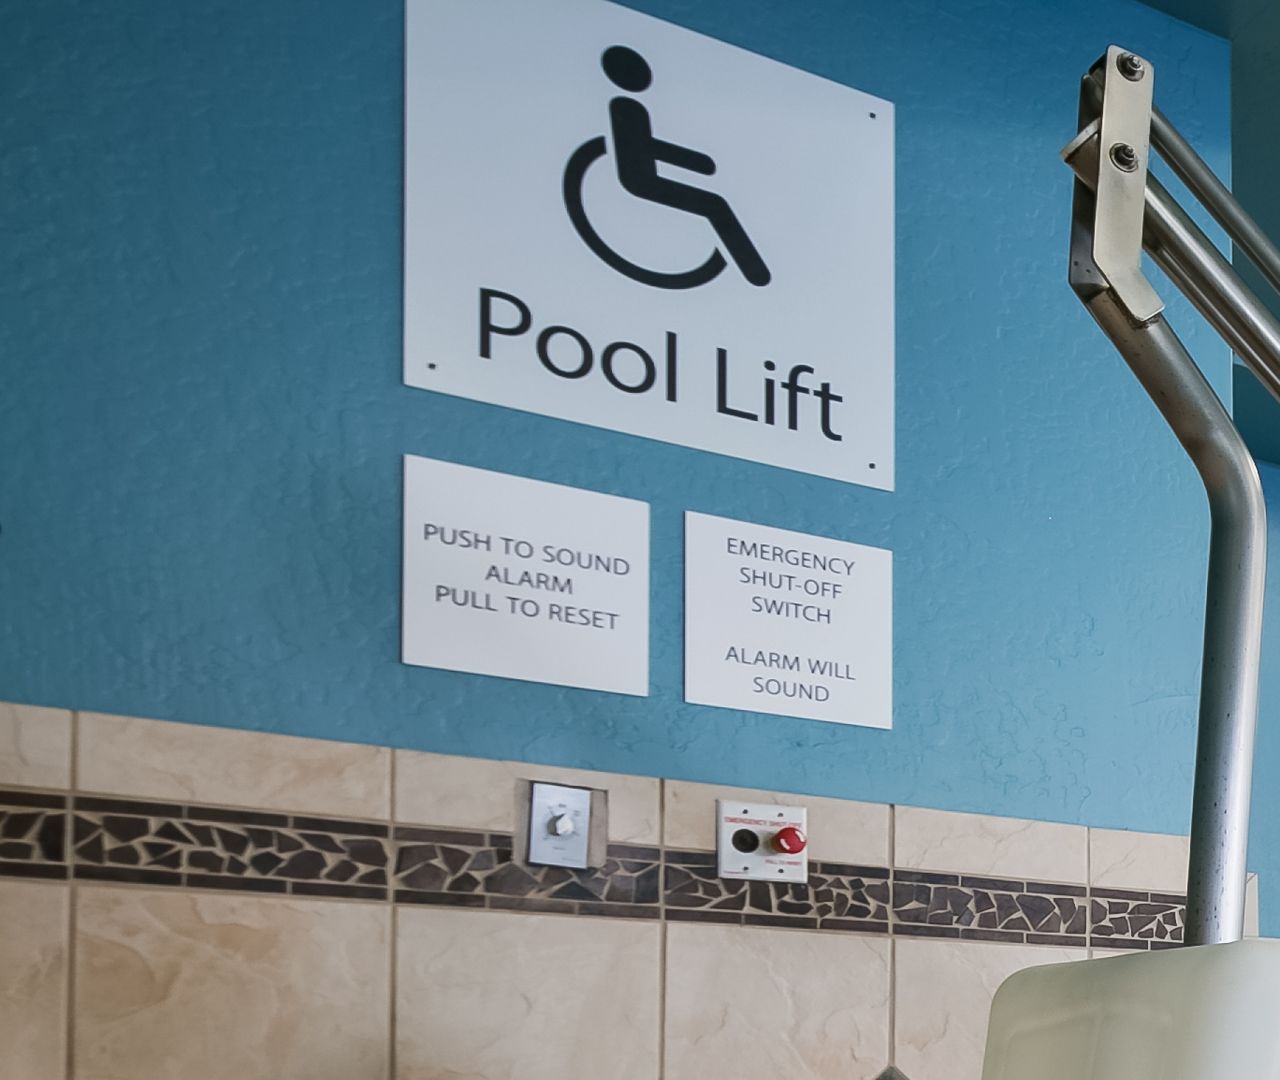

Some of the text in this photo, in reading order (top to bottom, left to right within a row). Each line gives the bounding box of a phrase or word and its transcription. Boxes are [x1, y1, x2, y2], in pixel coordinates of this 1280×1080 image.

[479, 287, 843, 441] Pool Lift
[423, 523, 631, 576] PUSH TO SOUND
[726, 537, 856, 576] EMERGENCY
[484, 564, 574, 595] ALARM
[738, 567, 843, 600] SHUT-OFF
[434, 584, 620, 630] PULL TO RESET
[751, 595, 832, 625] SWITCH
[725, 645, 857, 681] ALARM WILL
[752, 676, 831, 703] SOUND
